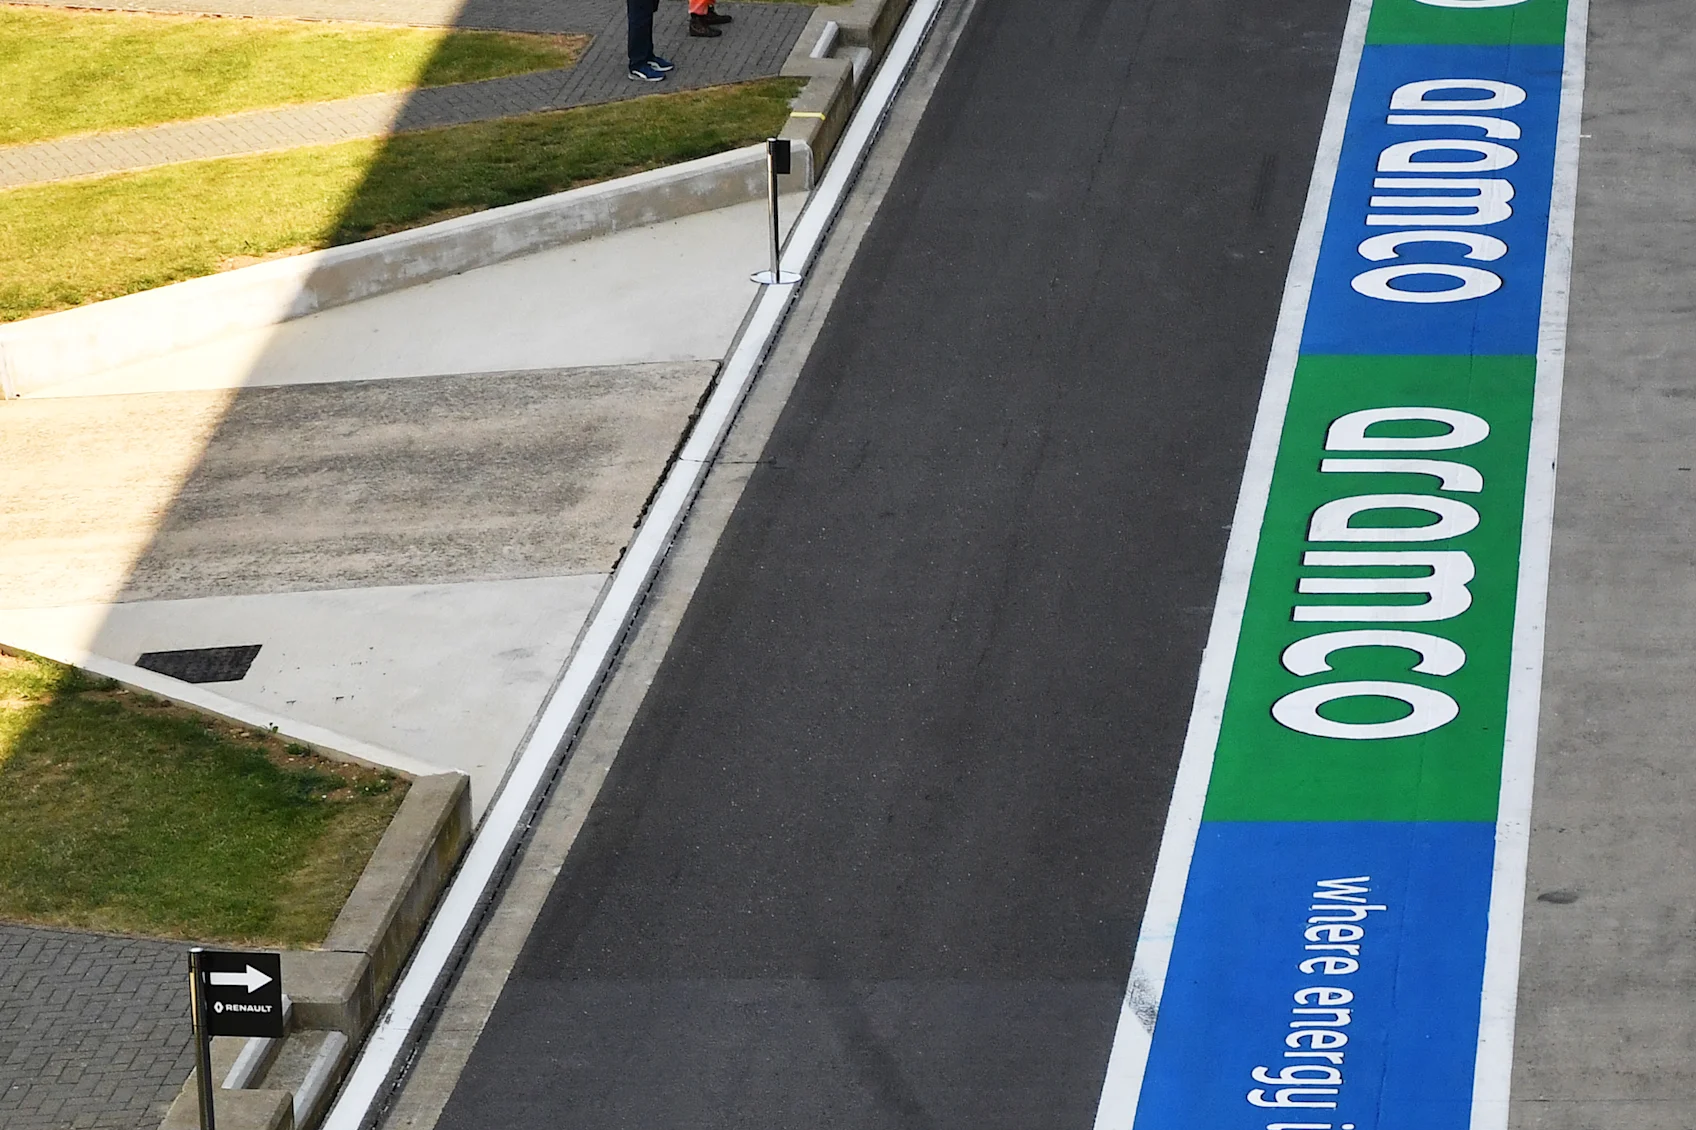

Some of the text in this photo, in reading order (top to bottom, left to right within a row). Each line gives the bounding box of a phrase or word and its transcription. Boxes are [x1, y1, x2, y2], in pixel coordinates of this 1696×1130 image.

[1350, 78, 1527, 304] aramco
[1270, 406, 1490, 740] aramco
[1299, 876, 1387, 974] where
[225, 1003, 272, 1013] RENAULT
[1247, 987, 1354, 1108] energy
